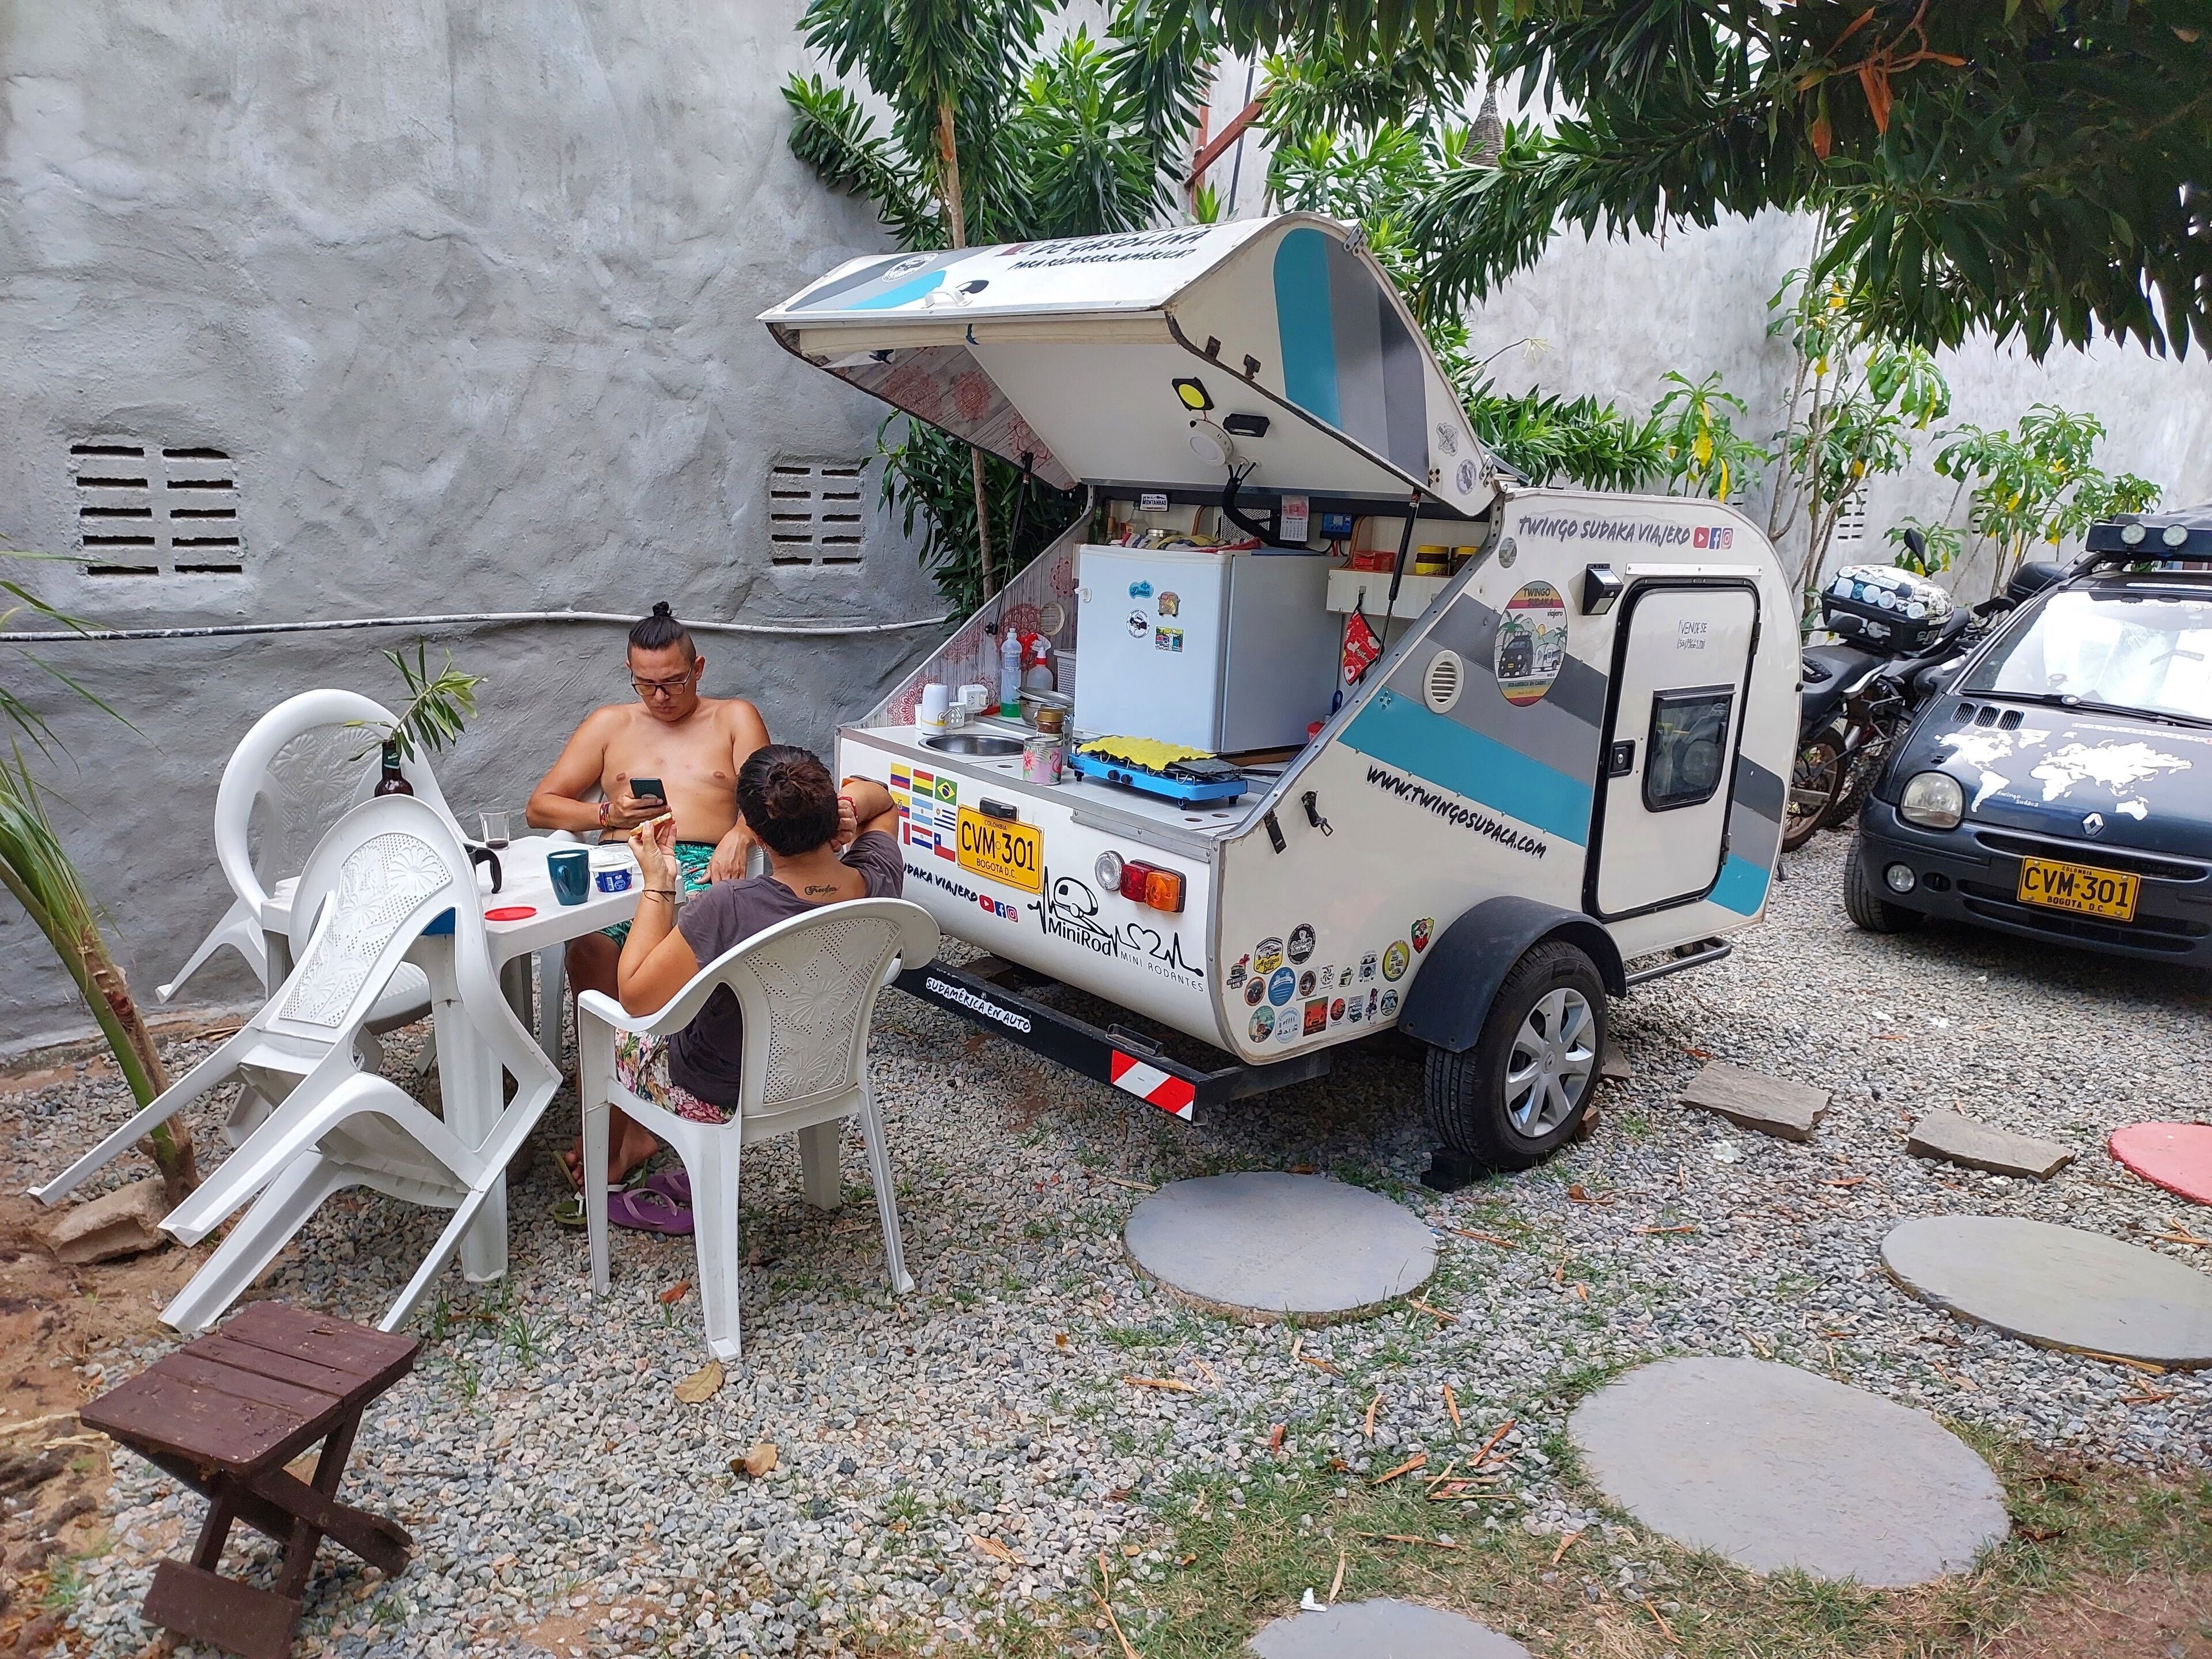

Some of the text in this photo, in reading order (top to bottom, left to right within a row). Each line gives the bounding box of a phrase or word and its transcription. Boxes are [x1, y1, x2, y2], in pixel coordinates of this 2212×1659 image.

[1029, 243, 1063, 256] DE
[1067, 229, 1212, 256] GASOLINA
[1519, 516, 1690, 548] TWINGO SUDAKA VIAJERO
[1523, 588, 1551, 597] TWINGO
[1528, 597, 1554, 607] SUDAKA
[1547, 609, 1563, 619] viajero
[984, 820, 1007, 831] COLOMBIA
[976, 858, 1017, 879] BOGOTA D.C.
[2062, 866, 2093, 876] COLOMBIA
[935, 874, 978, 902] VIAJERO
[2047, 896, 2105, 913] BOGOTA D.C.
[1048, 916, 1112, 956] MiniRod
[1120, 950, 1143, 967] MINI
[1147, 962, 1204, 992] RODANTES
[927, 979, 1030, 1031] SUDAMÉRICA EN AUTO
